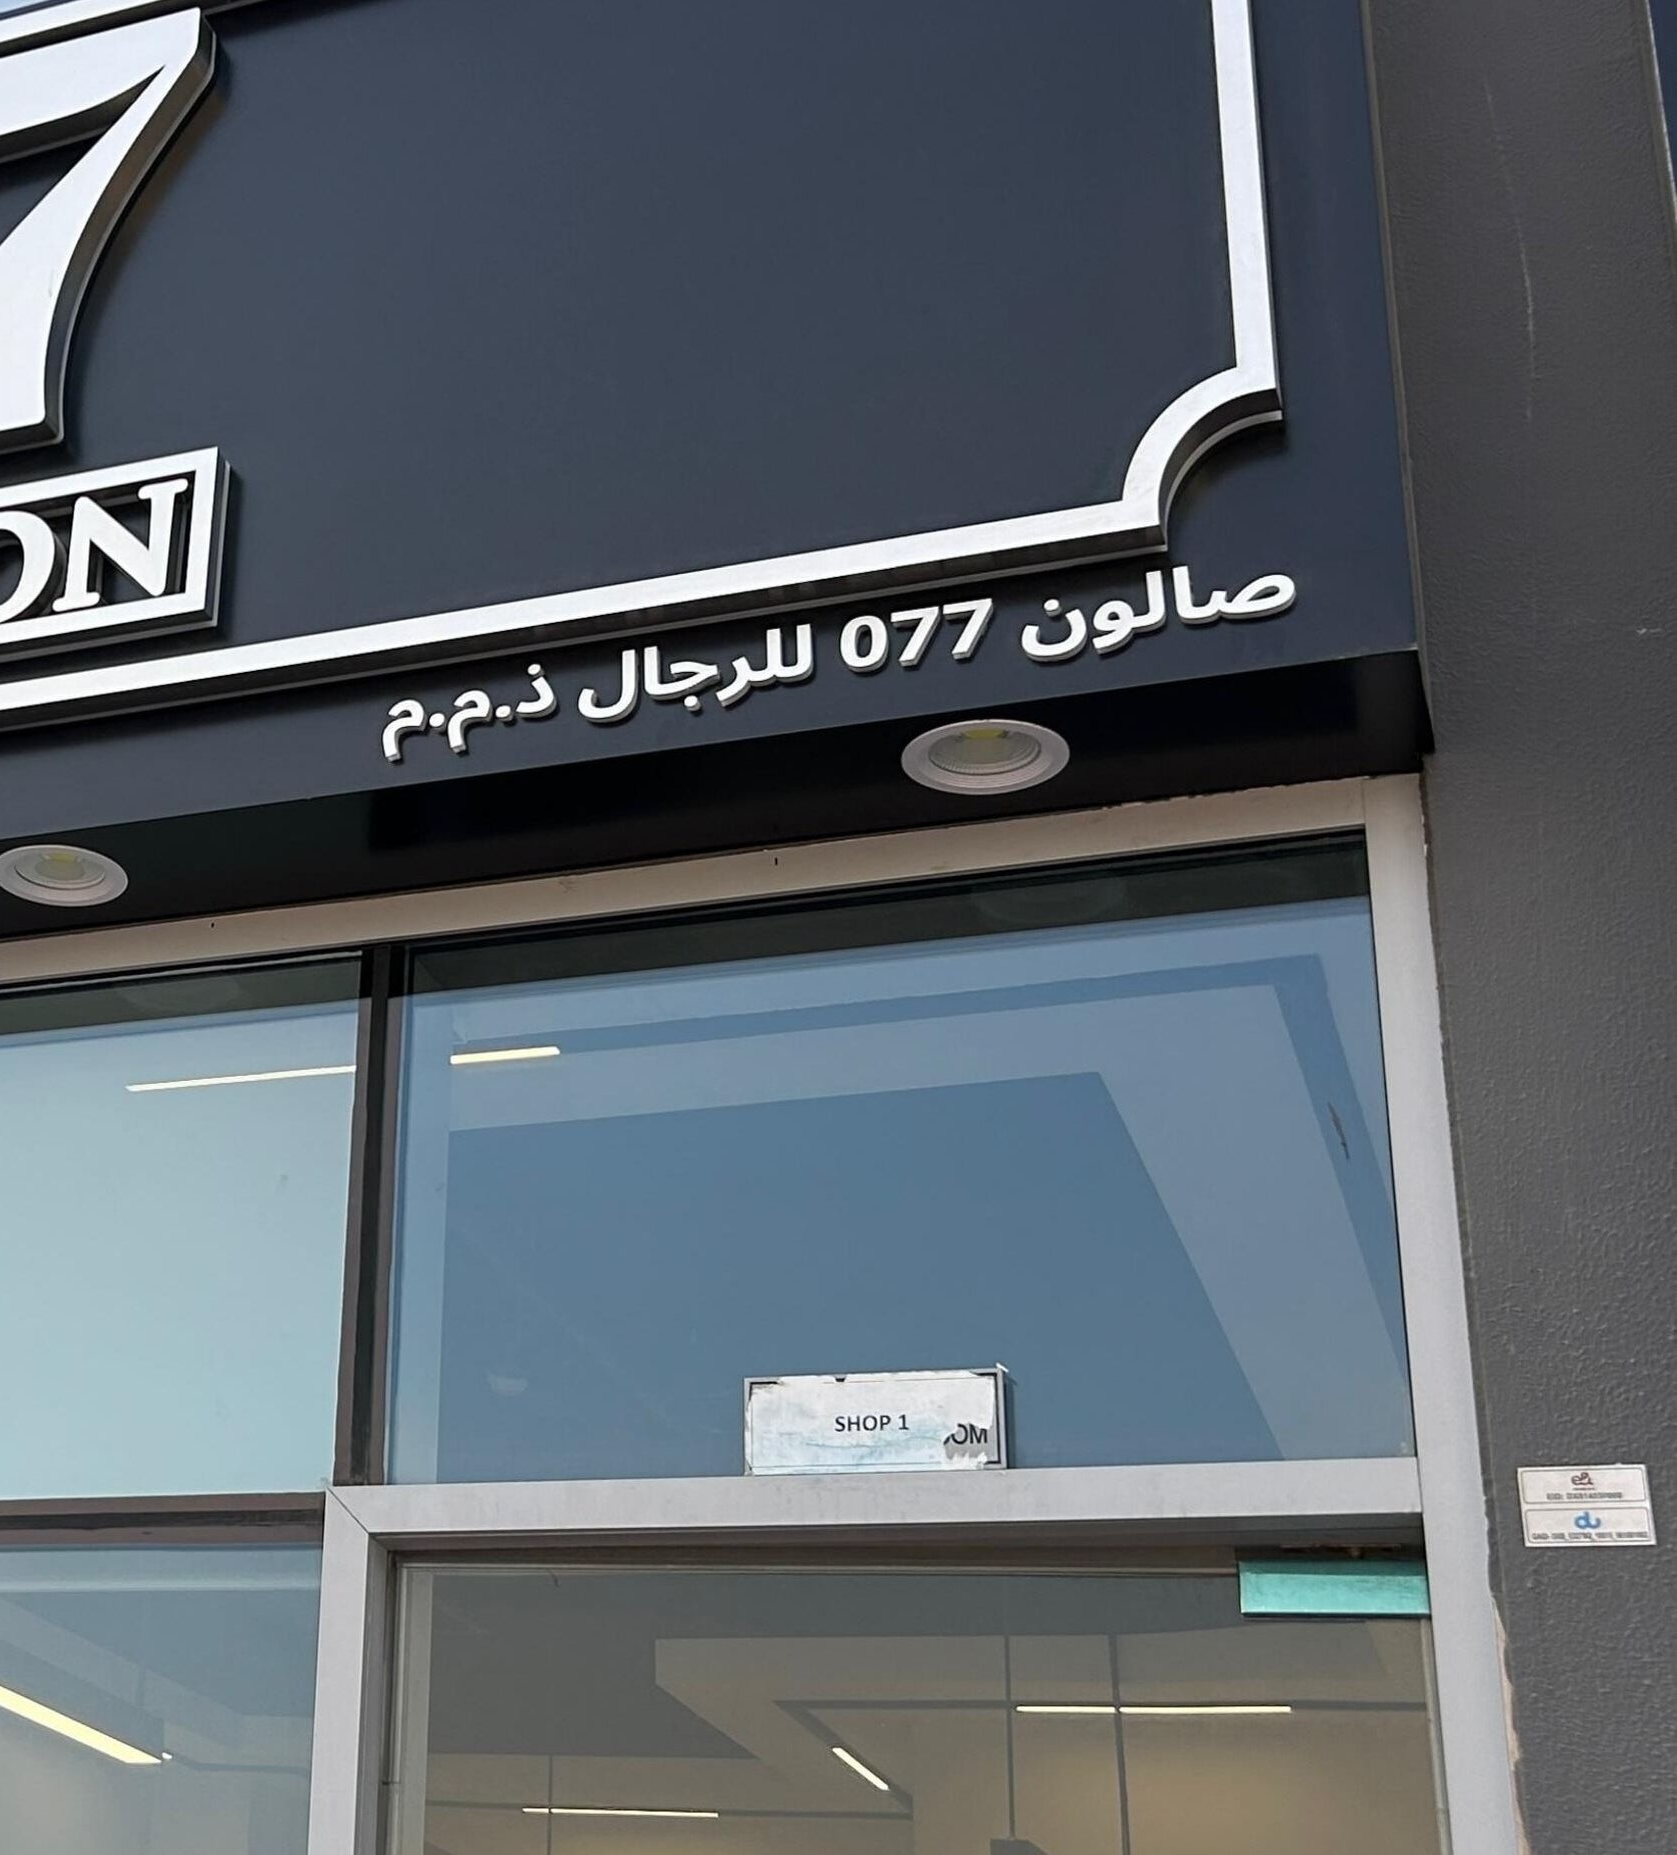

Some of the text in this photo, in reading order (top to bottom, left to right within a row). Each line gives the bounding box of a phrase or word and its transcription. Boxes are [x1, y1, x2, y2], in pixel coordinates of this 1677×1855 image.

[839, 598, 993, 671] 077
[1020, 565, 1296, 661] صالون
[576, 622, 813, 720] للرجال
[834, 1414, 909, 1432] SHOP 1
